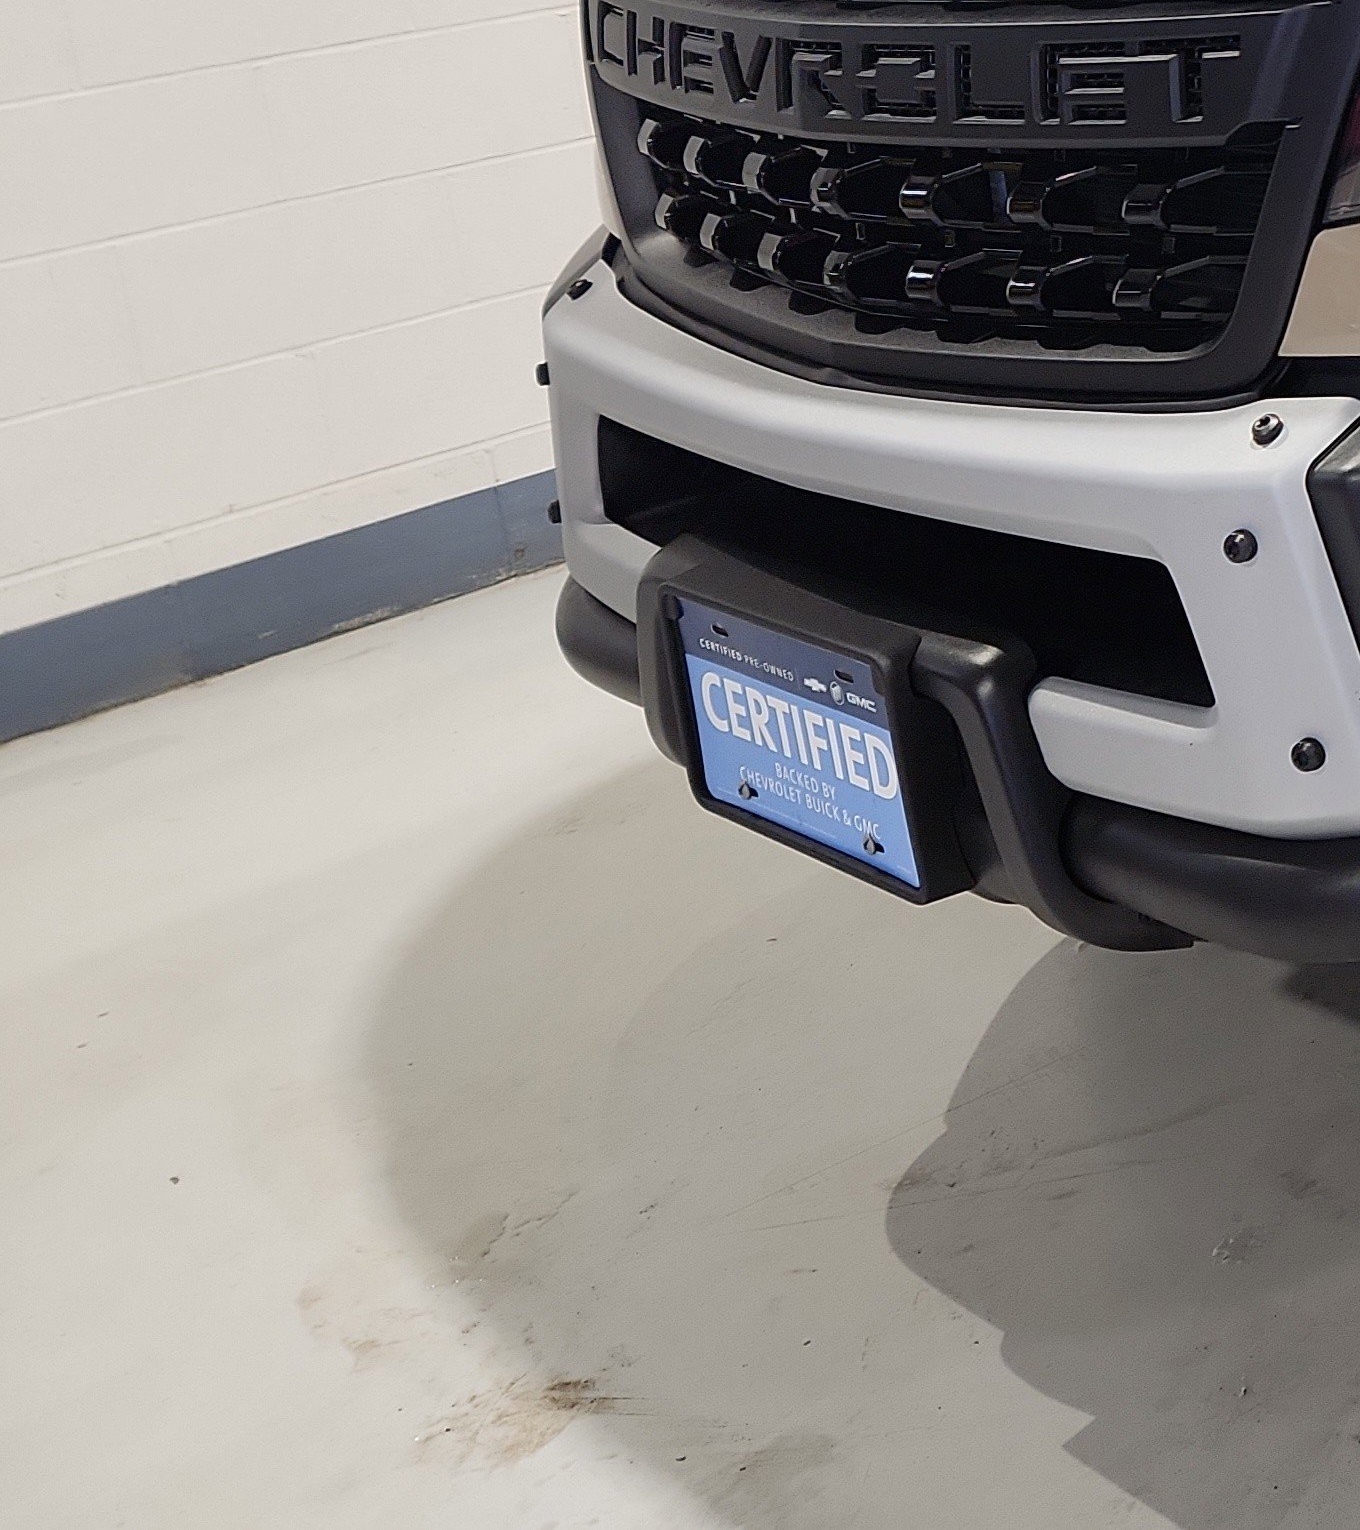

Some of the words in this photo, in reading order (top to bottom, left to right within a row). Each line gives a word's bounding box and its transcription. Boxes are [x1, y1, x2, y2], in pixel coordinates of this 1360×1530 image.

[596, 0, 1241, 125] CHEVROLET
[699, 638, 742, 663] CERTIFIED
[744, 654, 795, 683] PRE-OWNED
[846, 692, 877, 713] GMC
[701, 671, 898, 800] CERTIFIED
[739, 766, 802, 805] CHEVROLET
[805, 794, 841, 822] BUICK
[842, 809, 852, 826] &
[854, 815, 882, 840] GMC
[774, 762, 819, 793] BACKED
[821, 781, 836, 800] BY
